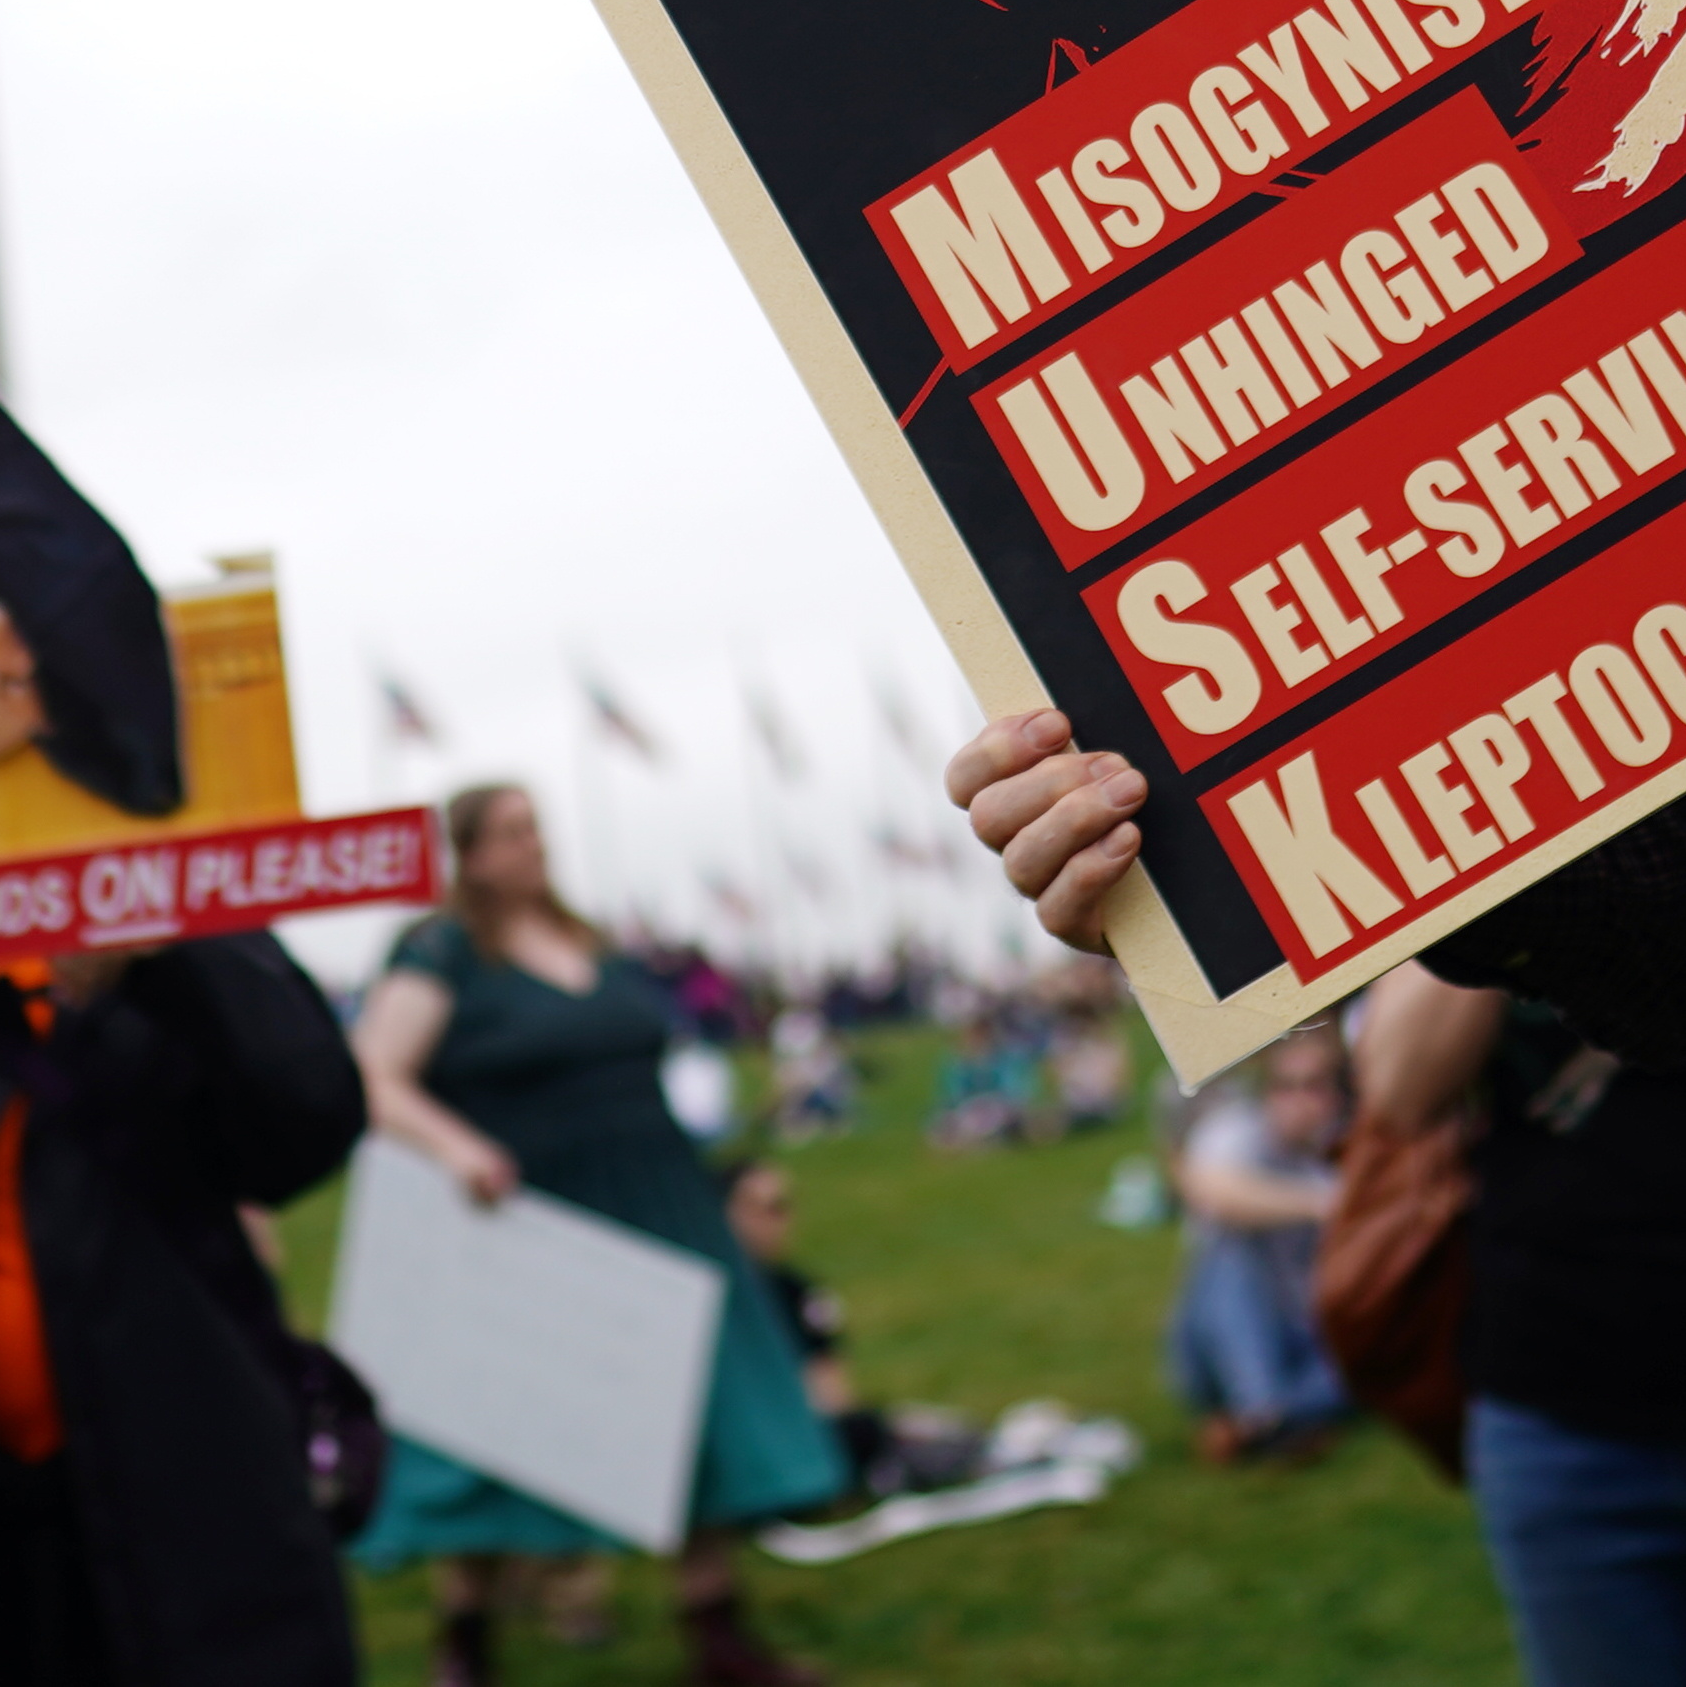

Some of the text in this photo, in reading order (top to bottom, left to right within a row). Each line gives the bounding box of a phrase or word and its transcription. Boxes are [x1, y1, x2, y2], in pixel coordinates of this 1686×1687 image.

[996, 161, 1550, 533] UNHINGED
[79, 852, 180, 917] ON
[184, 821, 422, 908] PLEASE!
